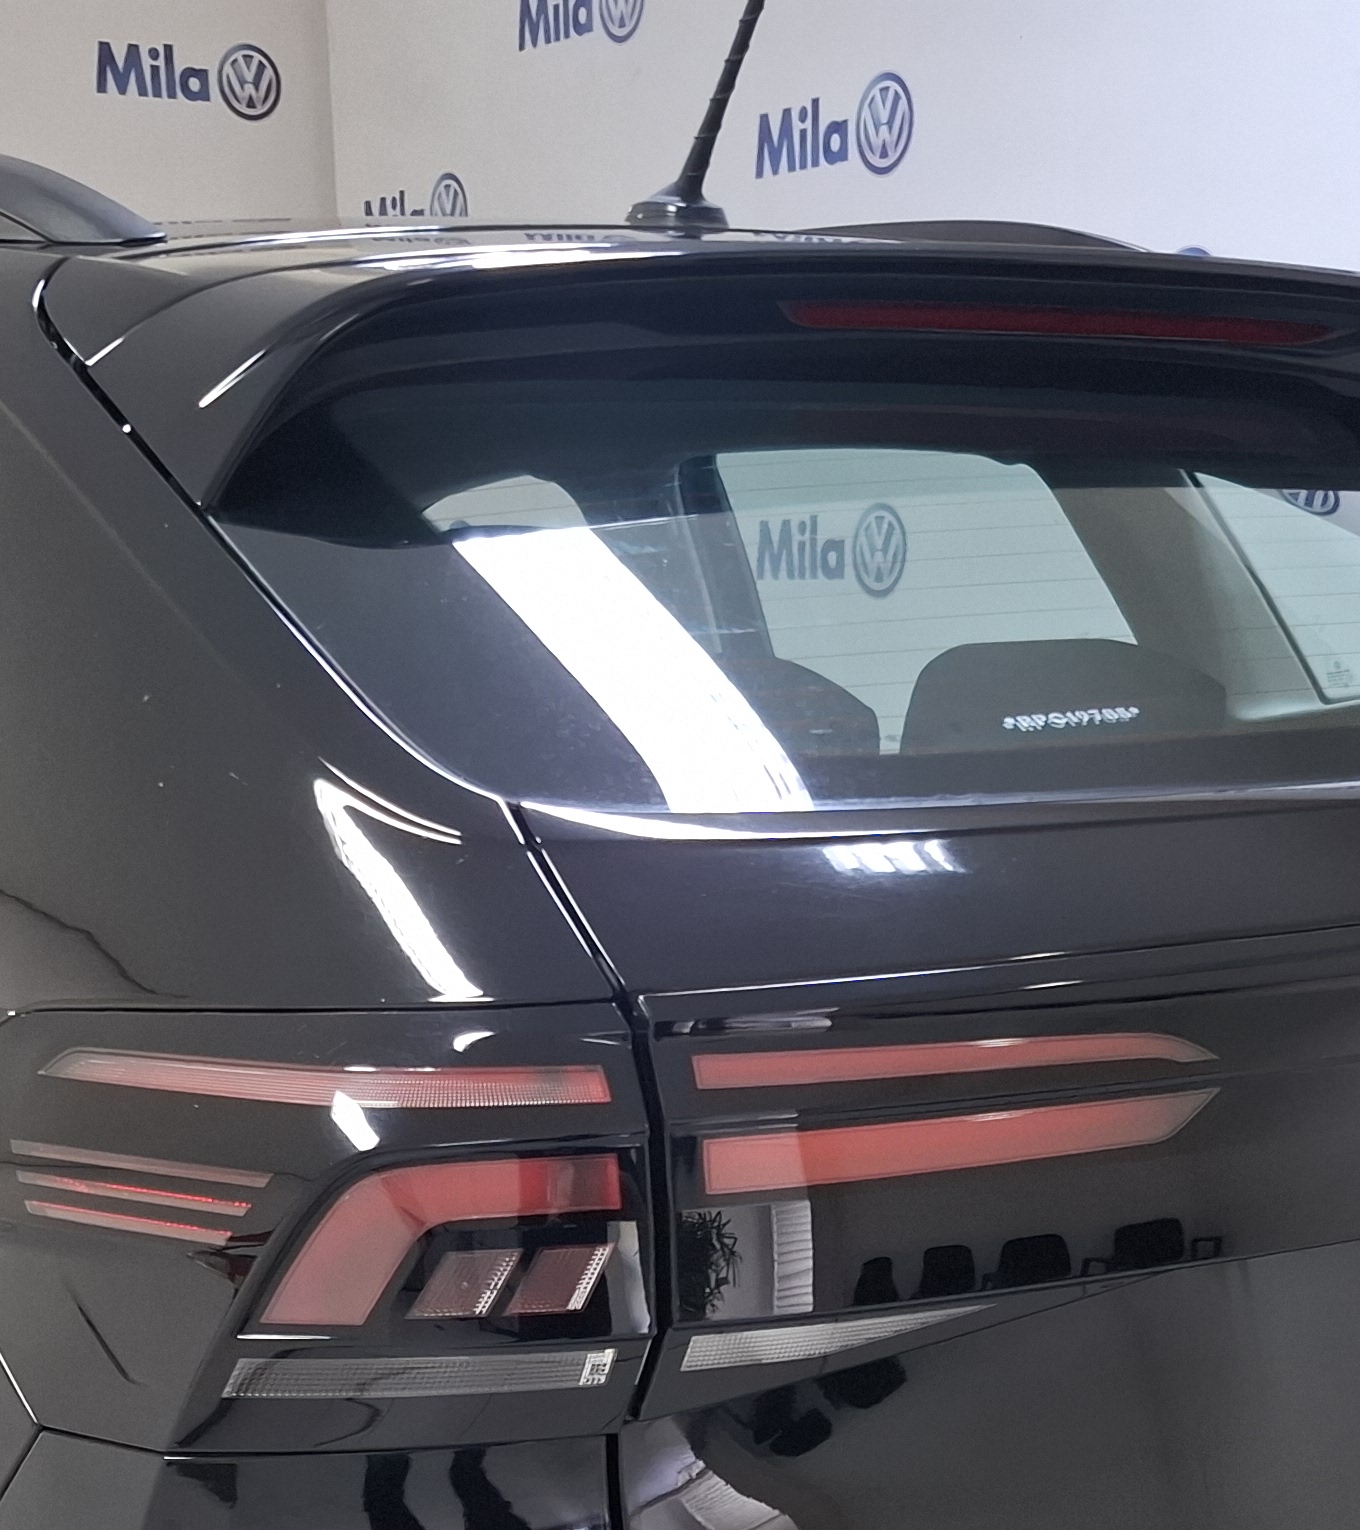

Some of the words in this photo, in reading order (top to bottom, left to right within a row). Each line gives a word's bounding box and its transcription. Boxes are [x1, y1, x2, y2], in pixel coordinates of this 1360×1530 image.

[96, 40, 211, 104] Mila
[755, 97, 849, 179] Mila
[756, 514, 846, 581] Mila
